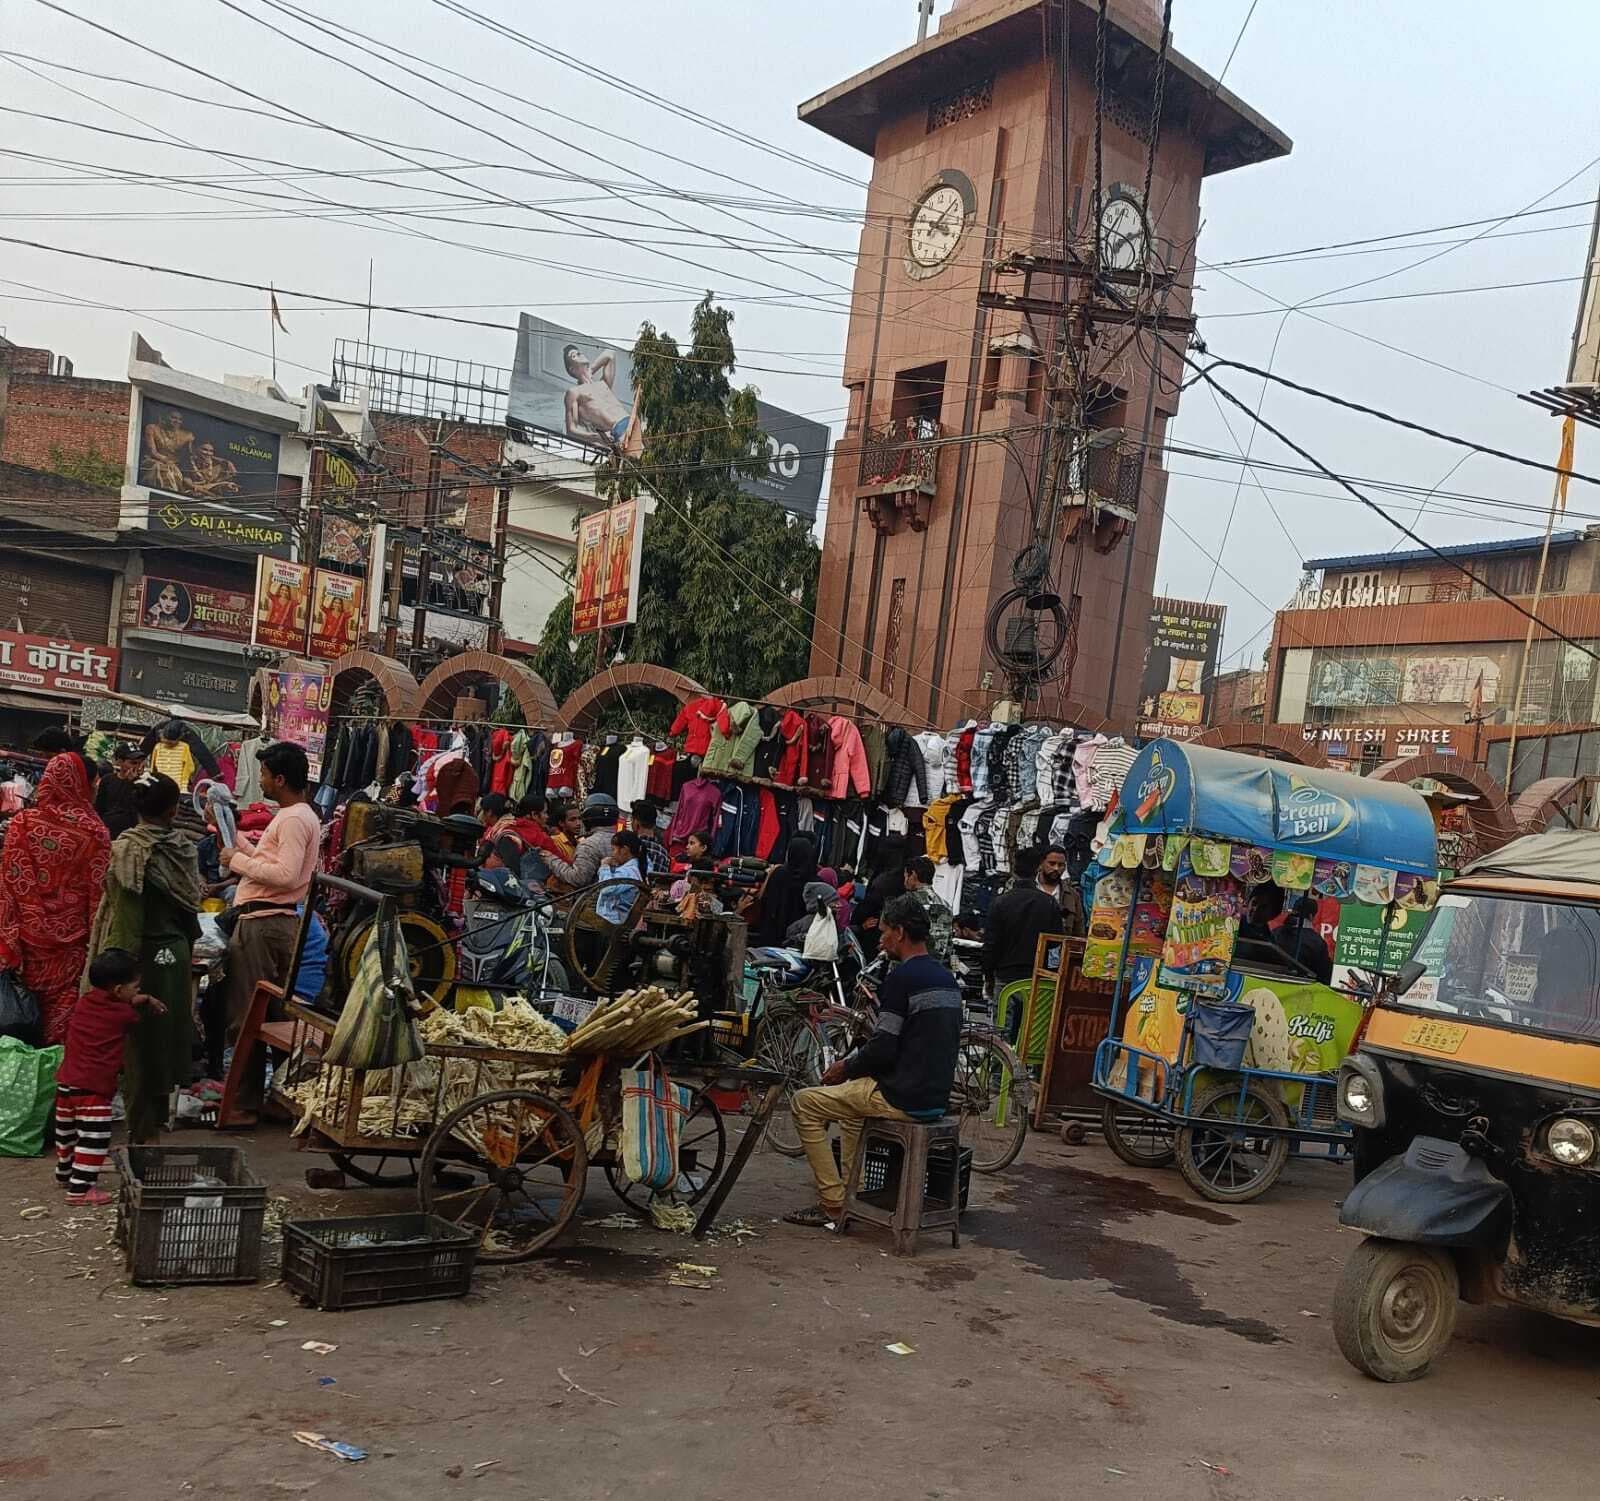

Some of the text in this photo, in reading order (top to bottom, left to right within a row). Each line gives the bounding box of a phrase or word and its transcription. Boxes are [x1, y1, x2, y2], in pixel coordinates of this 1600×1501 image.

[189, 512, 214, 530] SAI
[217, 520, 284, 543] ALANKAR
[25, 641, 111, 679] कॉर्नर
[18, 672, 42, 684] Wear
[60, 680, 81, 689] Kids
[1395, 728, 1451, 744] SHREE
[1279, 800, 1337, 823] Cream
[1294, 815, 1329, 836] Bell
[1342, 943, 1357, 956] 15
[1288, 1014, 1336, 1045] Kulfi
